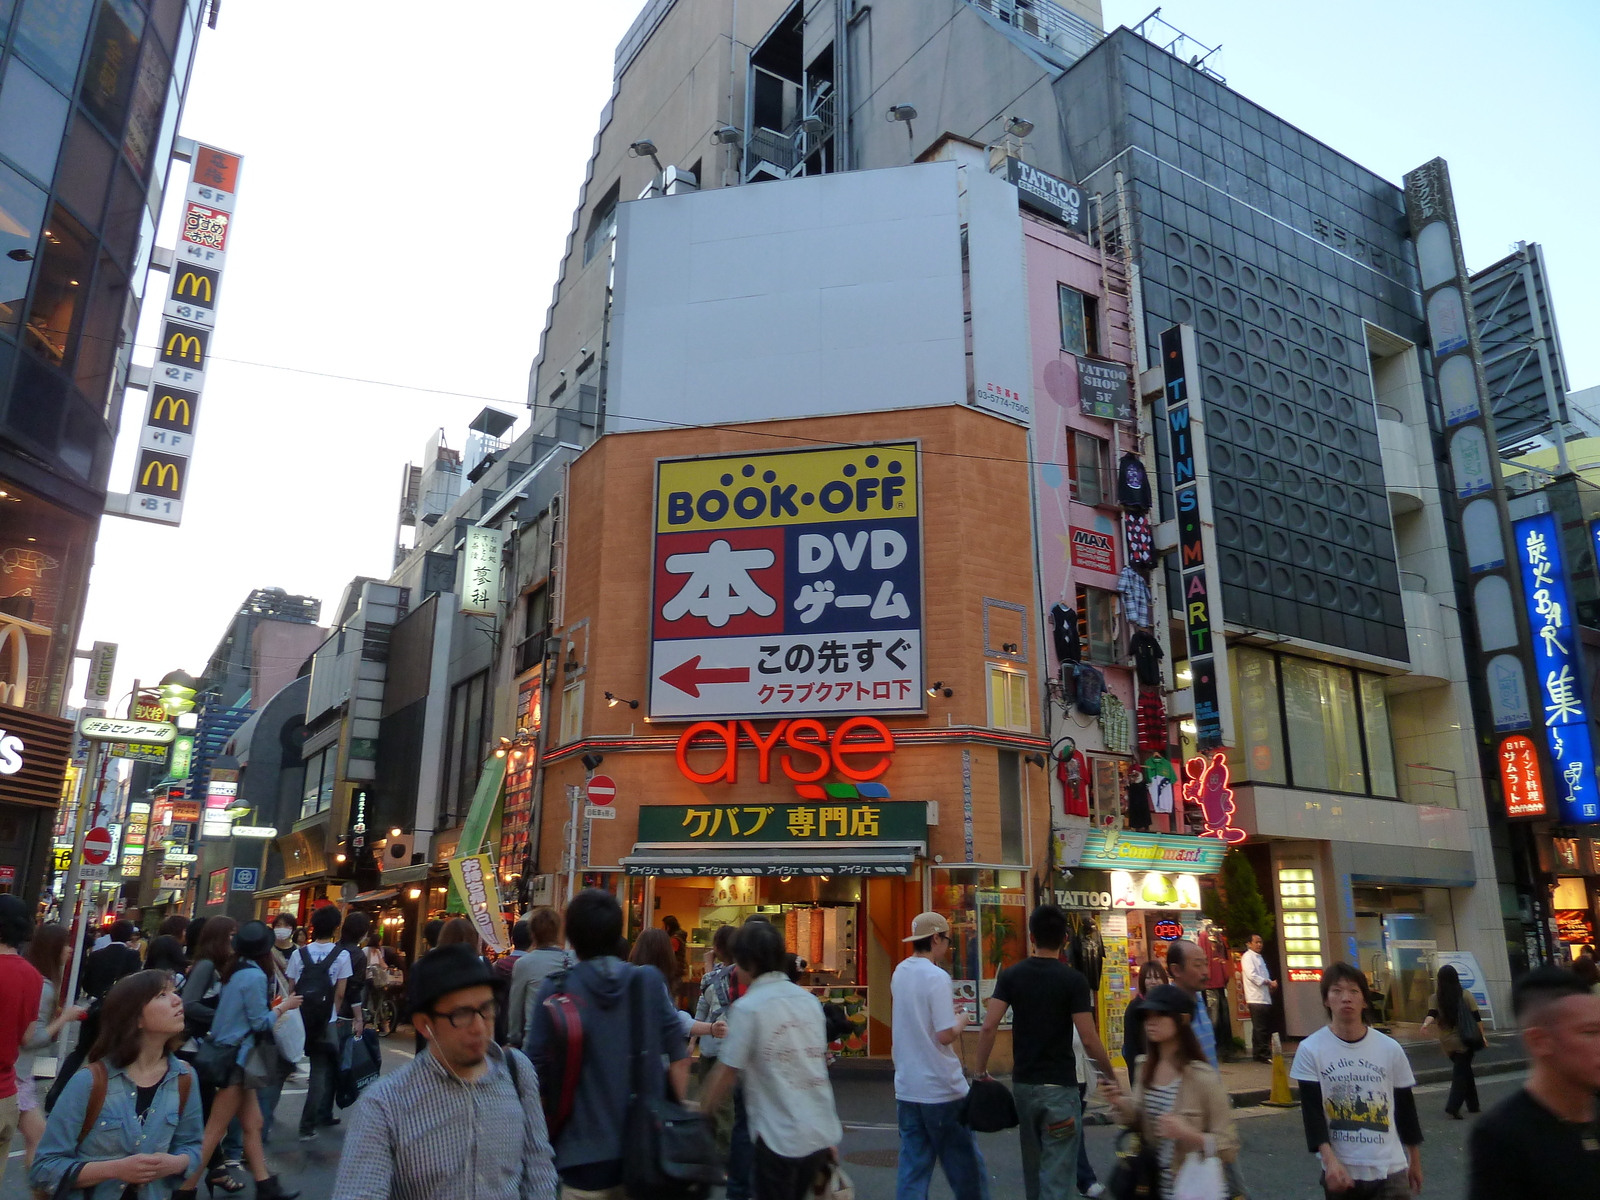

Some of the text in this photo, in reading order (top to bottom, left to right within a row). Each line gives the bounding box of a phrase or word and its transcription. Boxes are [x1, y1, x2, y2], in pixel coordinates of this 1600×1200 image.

[1018, 161, 1080, 208] TATTOO
[1078, 362, 1127, 381] TATTOO
[1083, 375, 1120, 391] SHOP
[977, 389, 1030, 415] 03-5774-7506
[1096, 391, 1113, 403] 5F
[798, 529, 908, 574] DVD
[1073, 530, 1113, 551] MAX
[662, 539, 777, 628] 本
[794, 580, 911, 624] ゲーム
[757, 637, 912, 675] この先すぐ
[757, 679, 912, 705] クラブクアトロ下
[1505, 740, 1526, 750] B1F
[1503, 751, 1521, 804] サムラート
[1521, 750, 1540, 802] インド料理
[682, 805, 881, 838] ケバブ 専門店
[629, 865, 871, 876] アイシェ アイシェ アイシェ アイシェ
[1055, 890, 1112, 907] TATTOO
[1154, 923, 1182, 937] OPEN
[1337, 1057, 1355, 1068] die
[1332, 1130, 1385, 1145] Bilderbuch
